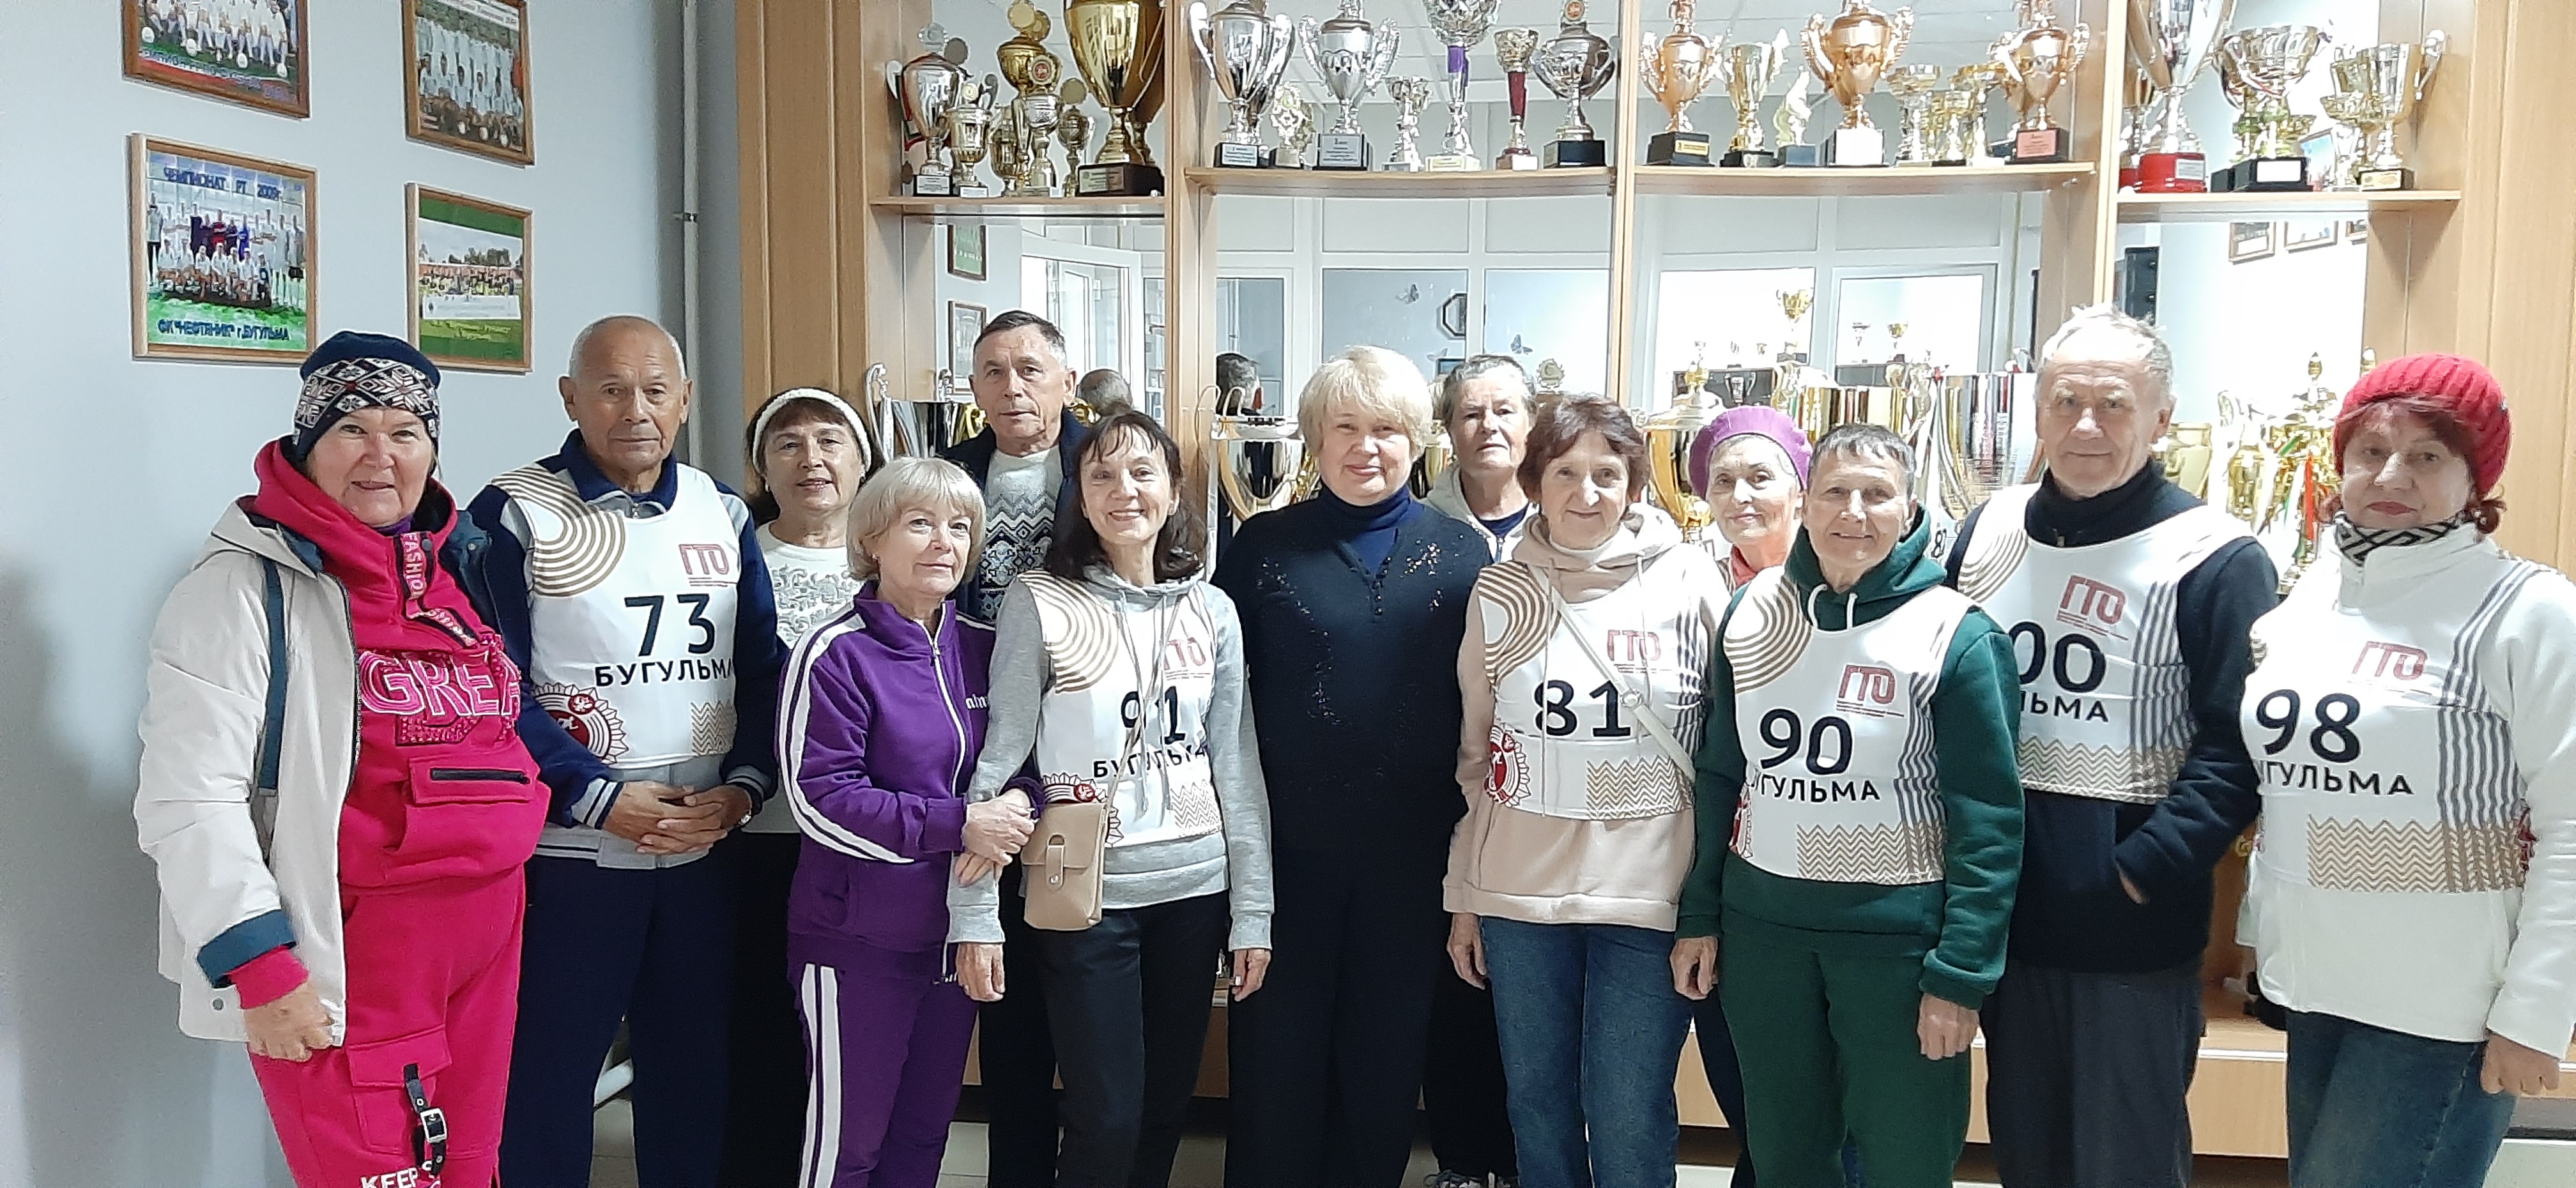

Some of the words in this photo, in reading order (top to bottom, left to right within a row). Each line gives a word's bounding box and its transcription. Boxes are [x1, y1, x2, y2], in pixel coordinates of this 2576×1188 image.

[678, 544, 730, 575] ГТО
[2060, 575, 2126, 625] ГТО
[624, 593, 716, 657] 73
[1607, 629, 1661, 661] ГТО
[2352, 641, 2428, 680] ГТО
[1838, 664, 1896, 704] ГТО
[1533, 680, 1631, 738] 81
[2255, 689, 2361, 764] 98
[1759, 708, 1853, 775] 90
[1756, 771, 1881, 803] ГУЛЬМА
